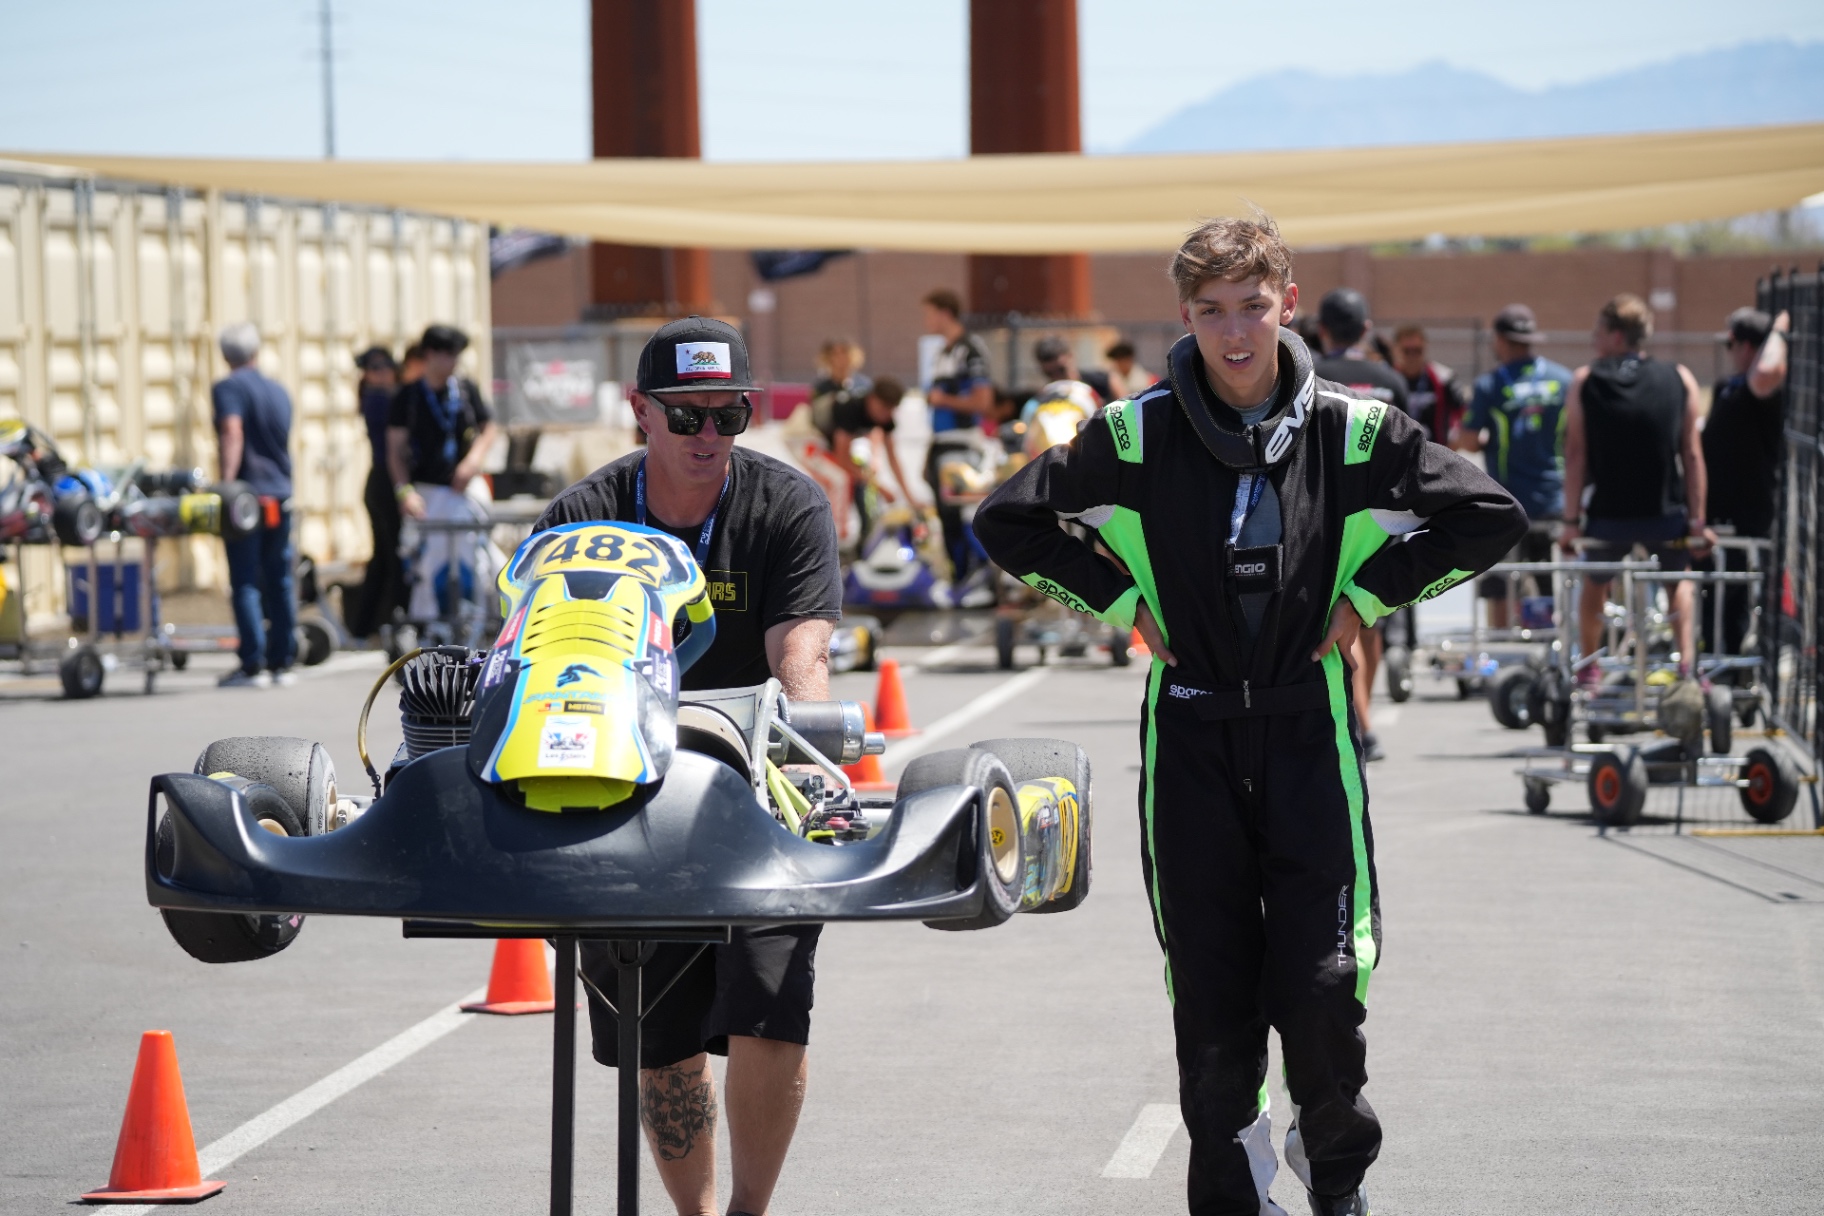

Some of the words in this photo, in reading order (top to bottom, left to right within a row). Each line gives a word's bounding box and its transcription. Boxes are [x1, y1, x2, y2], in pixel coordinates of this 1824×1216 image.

[1109, 405, 1131, 452] sparco
[1357, 405, 1383, 453] sparco
[543, 533, 660, 584] 482
[522, 690, 618, 705] PANTAN
[1168, 684, 1213, 699] spar
[1337, 883, 1350, 968] THUNDER
